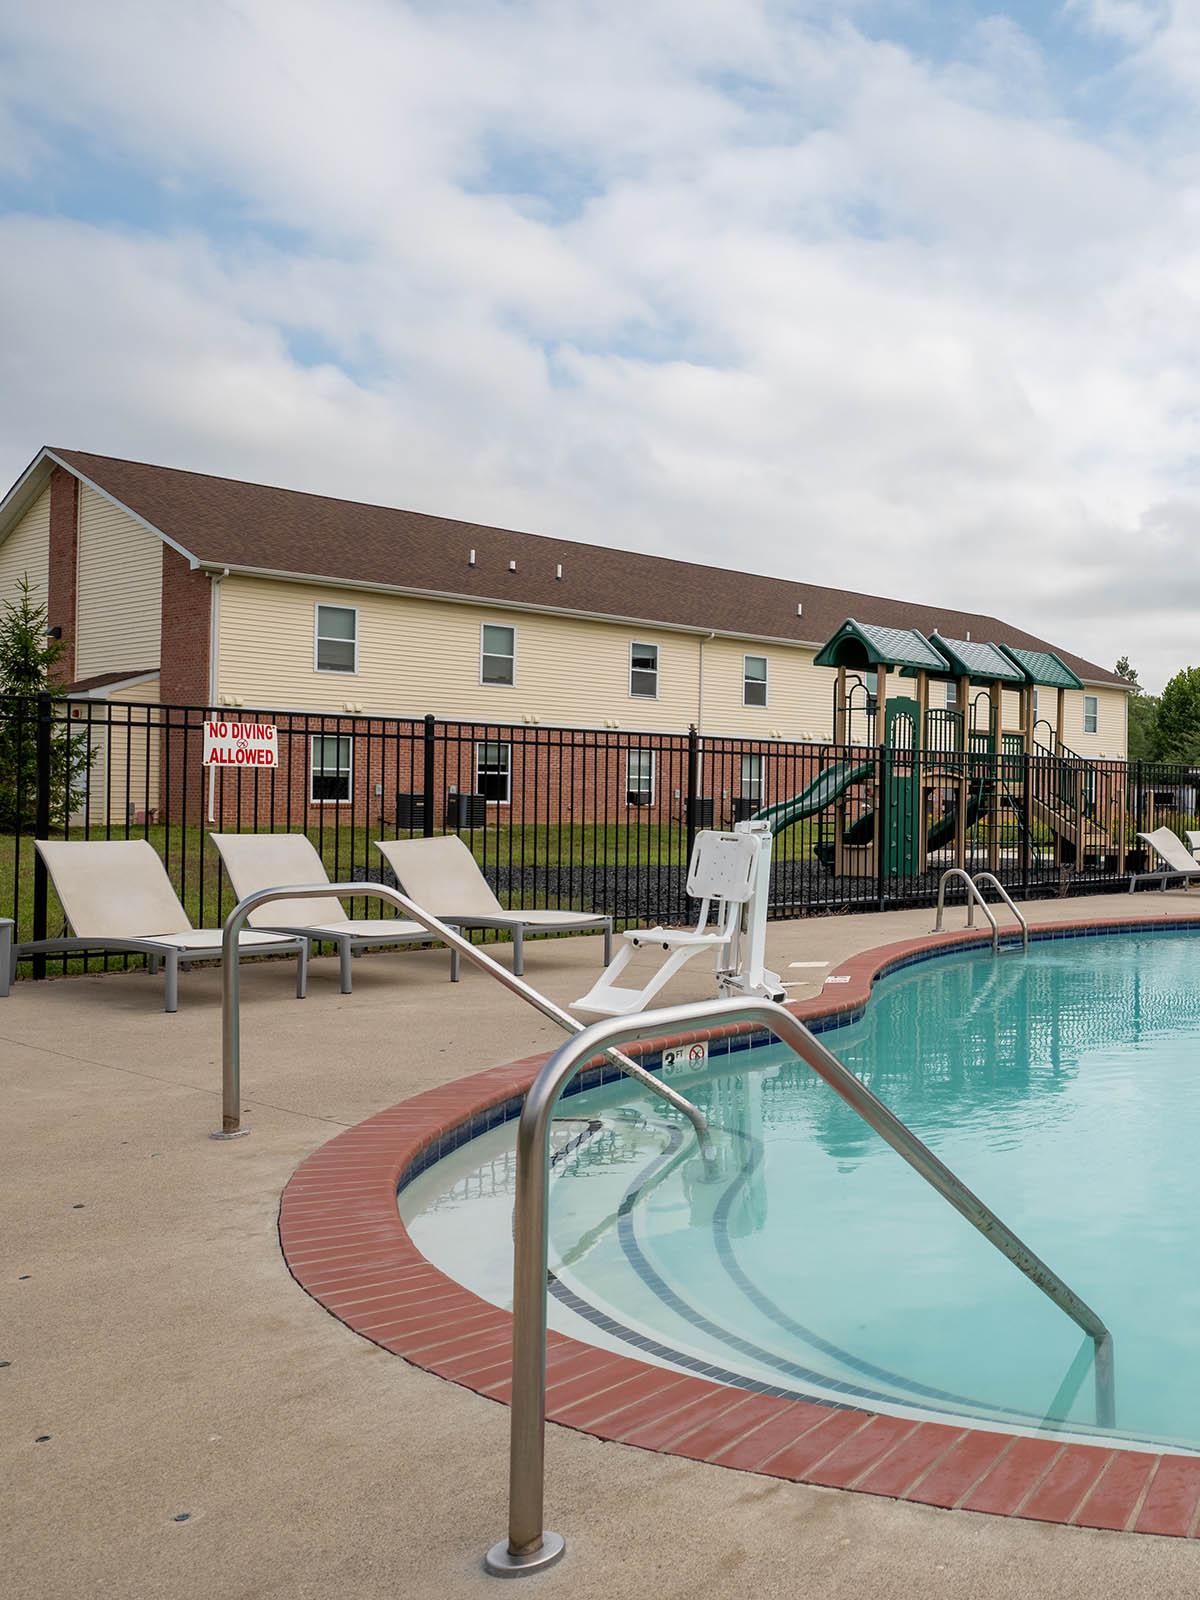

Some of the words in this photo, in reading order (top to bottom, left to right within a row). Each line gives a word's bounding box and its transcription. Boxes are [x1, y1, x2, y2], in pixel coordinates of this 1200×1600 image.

[209, 722, 228, 738] NO
[231, 723, 273, 740] DIVING
[209, 747, 274, 765] ALLOWED
